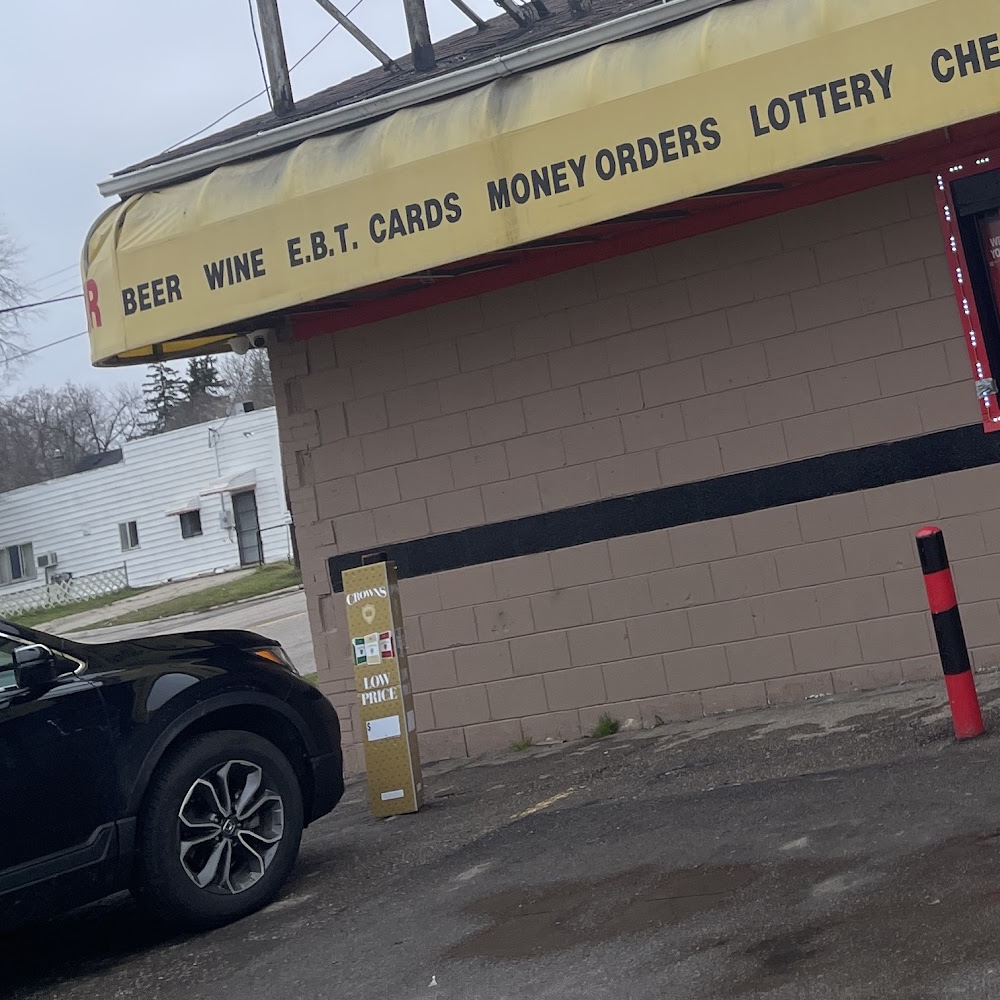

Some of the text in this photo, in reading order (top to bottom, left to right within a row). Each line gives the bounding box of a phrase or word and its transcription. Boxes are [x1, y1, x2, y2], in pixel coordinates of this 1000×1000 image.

[122, 274, 183, 317] BEER
[203, 247, 266, 291] WINE
[286, 222, 358, 268] E.B.T.
[368, 191, 463, 244] CARDS
[486, 154, 588, 212] MONEY
[594, 116, 722, 181] ORDERS
[749, 63, 894, 138] LOTTERY
[346, 585, 388, 606] CROWNS
[363, 672, 391, 690] LOW
[361, 686, 398, 706] PRICE
